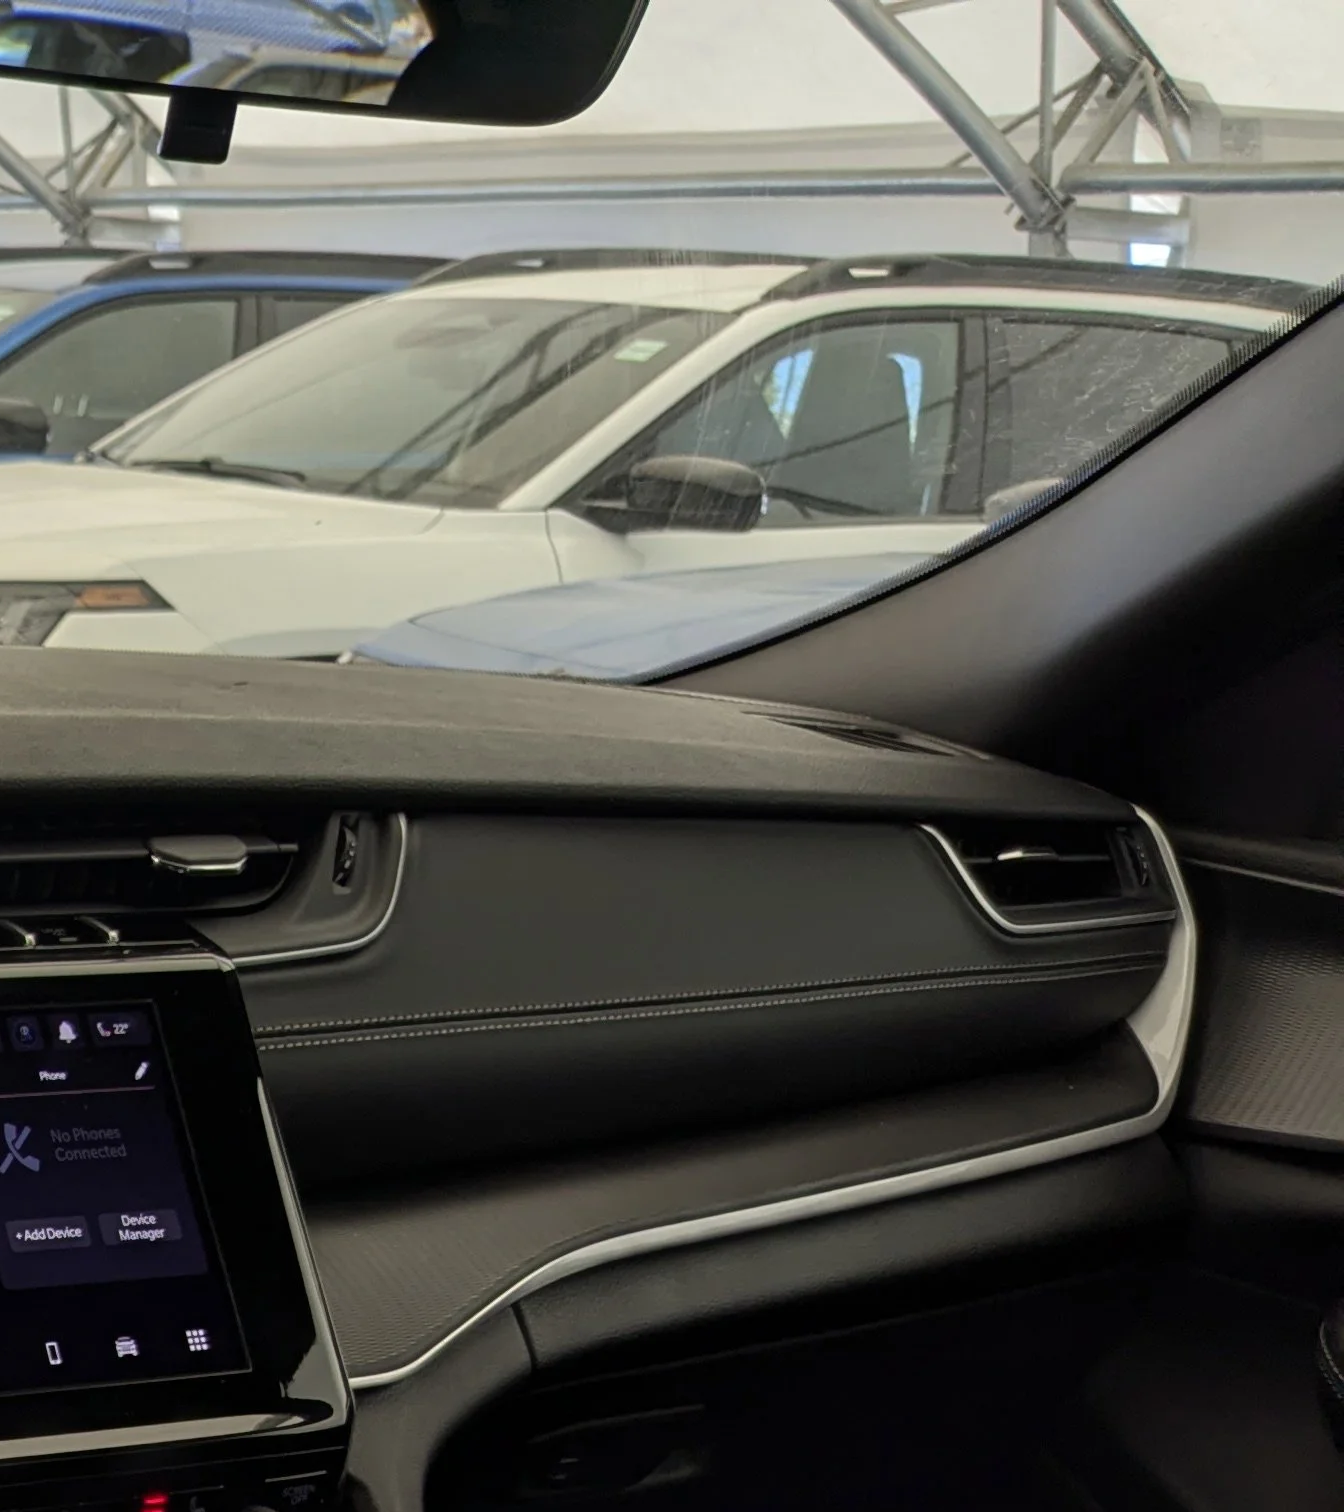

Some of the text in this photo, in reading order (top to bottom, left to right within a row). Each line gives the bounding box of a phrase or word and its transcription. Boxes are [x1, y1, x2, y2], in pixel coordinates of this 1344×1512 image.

[39, 1070, 67, 1081] Phone
[50, 1127, 121, 1143] No Phones
[54, 1144, 127, 1161] Connected
[120, 1213, 157, 1226] Device
[46, 1226, 82, 1240] Device
[118, 1227, 165, 1242] Manager
